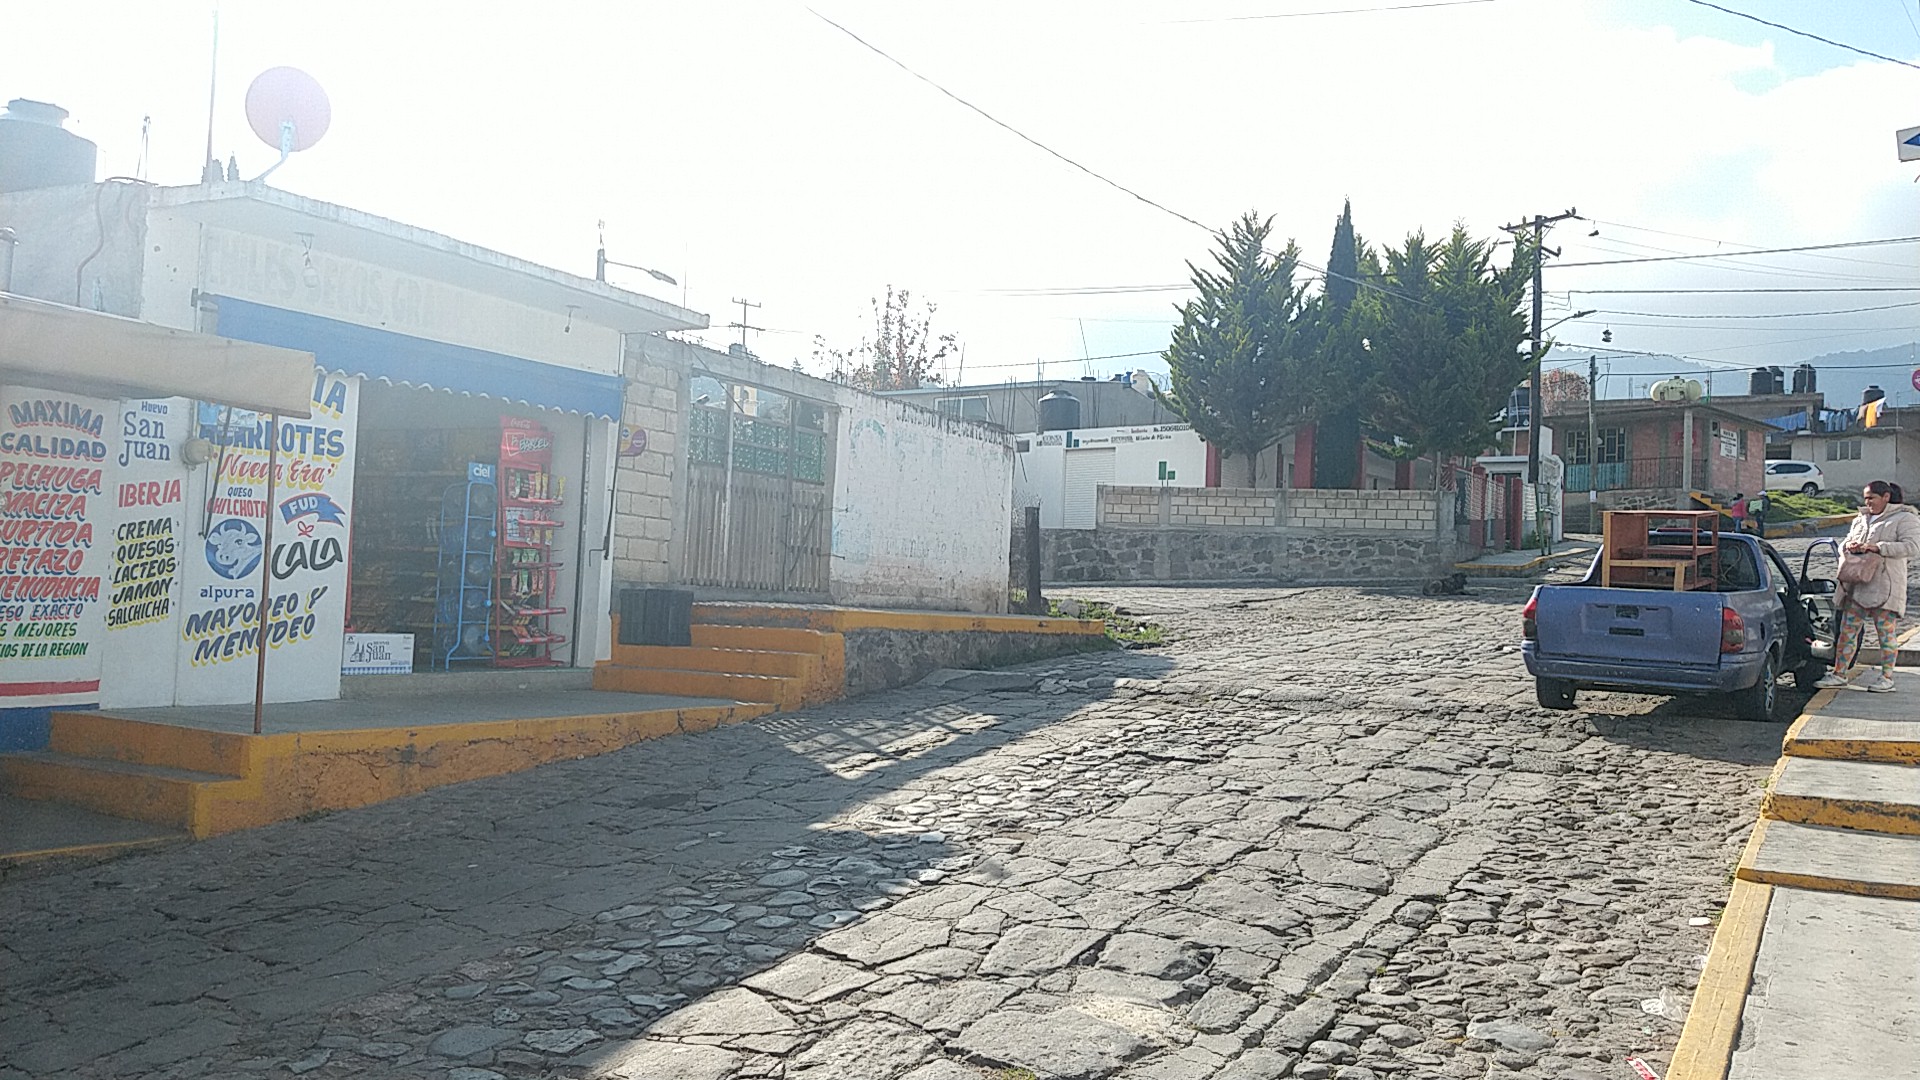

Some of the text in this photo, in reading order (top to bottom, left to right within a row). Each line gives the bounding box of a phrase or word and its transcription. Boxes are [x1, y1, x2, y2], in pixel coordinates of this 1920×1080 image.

[8, 400, 104, 438] MAXIMA
[123, 411, 166, 439] San
[0, 432, 107, 461] CALIDAD
[118, 440, 171, 467] Juan
[0, 461, 103, 495] PECHUGA
[473, 463, 491, 479] ciel
[118, 480, 181, 508] IBERIA
[227, 487, 253, 498] QUESO
[288, 496, 319, 517] FUD
[0, 519, 93, 548] URTIDA
[116, 517, 173, 542] CREMA
[116, 538, 175, 565] QUESOS
[271, 537, 344, 580] LALA
[112, 557, 177, 586] LACTEOS
[112, 577, 174, 606] JAMON
[200, 585, 255, 603] alpura
[0, 603, 84, 621] ESO EXACTO
[107, 598, 170, 629] SALCHICHA
[14, 622, 78, 639] MEJORES
[20, 643, 36, 658] DE
[49, 642, 89, 658] REGION
[366, 642, 385, 654] San
[366, 651, 392, 663] Juan
